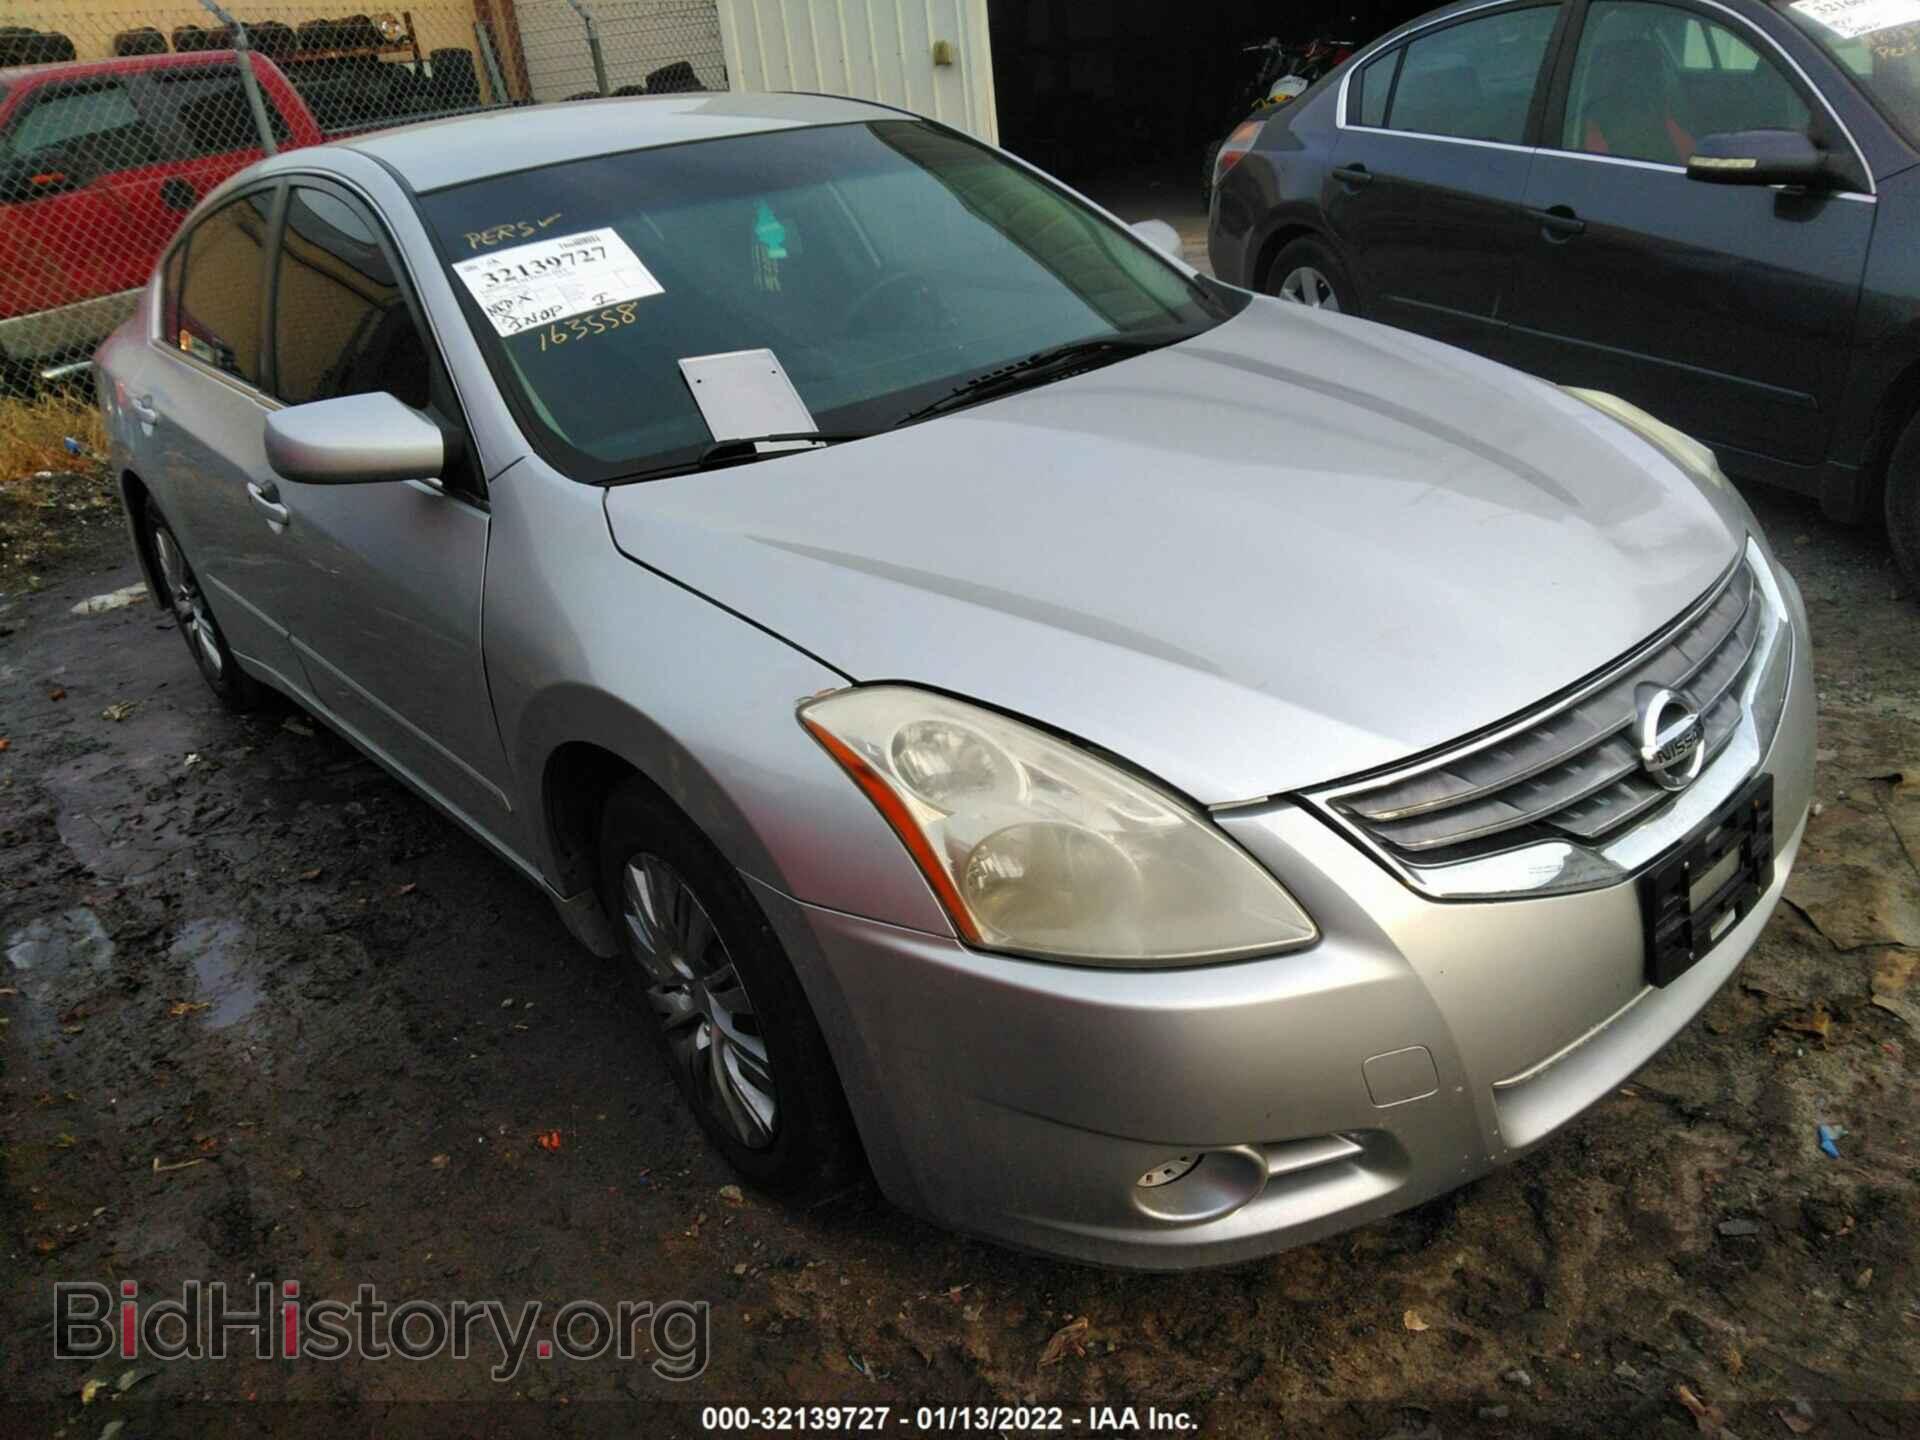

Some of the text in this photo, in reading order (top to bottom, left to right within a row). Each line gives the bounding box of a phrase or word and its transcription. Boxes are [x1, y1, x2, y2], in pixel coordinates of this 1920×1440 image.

[464, 222, 536, 249] PERS
[482, 246, 607, 287] 32139727
[540, 302, 638, 351] 163558
